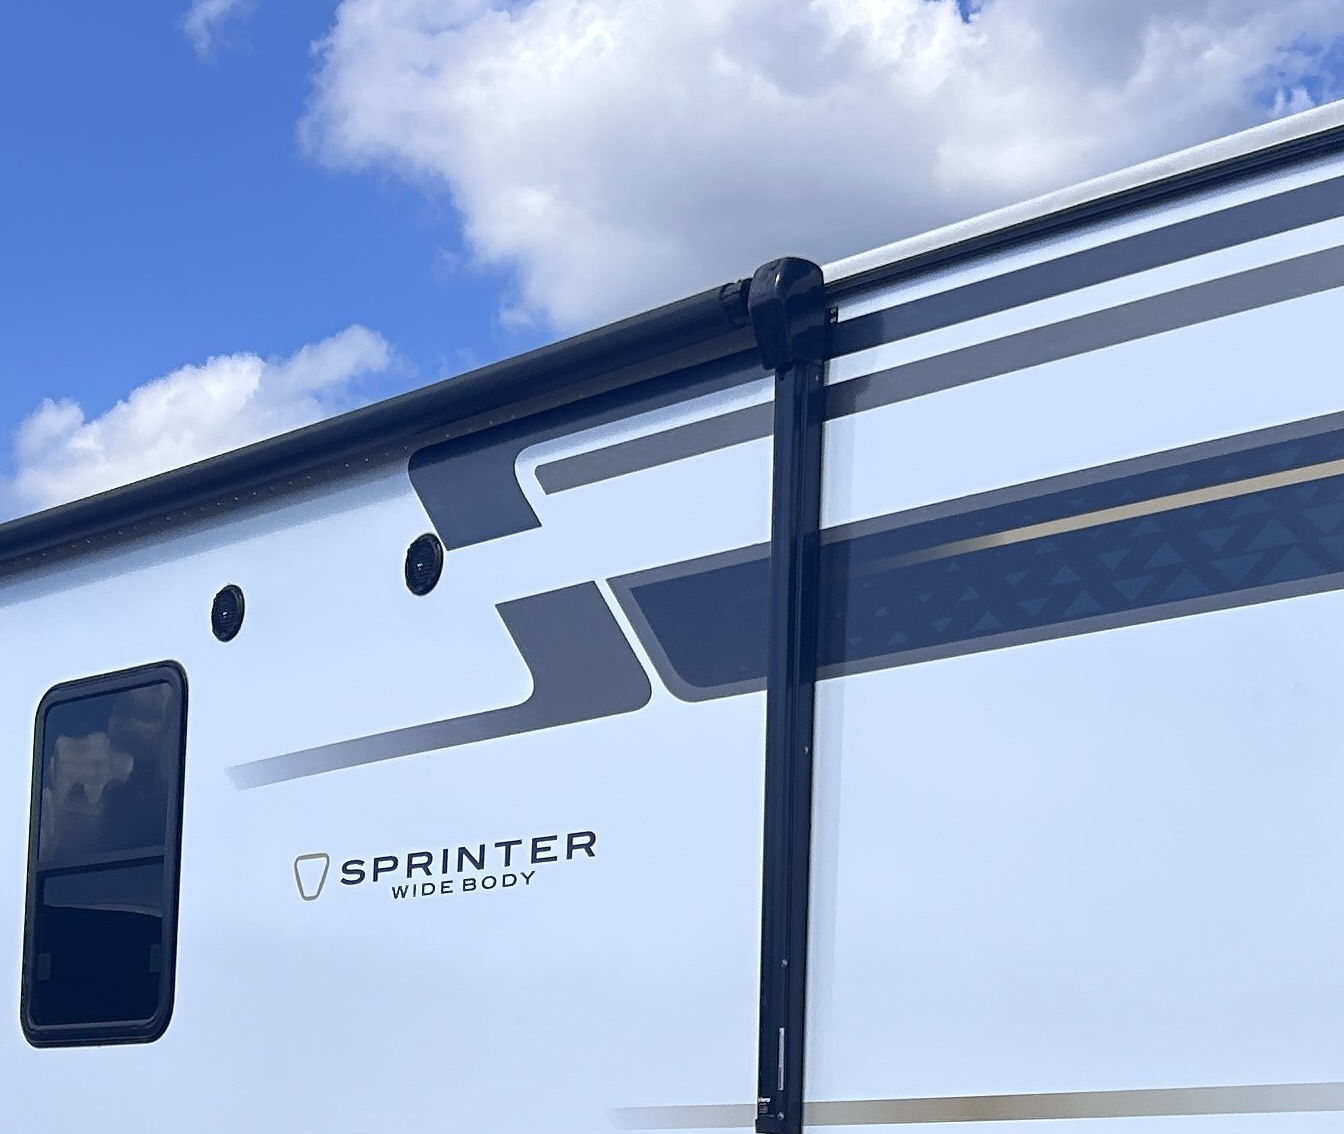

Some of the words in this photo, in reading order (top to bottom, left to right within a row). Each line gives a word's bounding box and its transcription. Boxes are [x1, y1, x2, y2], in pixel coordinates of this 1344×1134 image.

[340, 830, 597, 885] SPRINTER
[391, 880, 454, 900] WIDE
[462, 870, 536, 892] BODY
